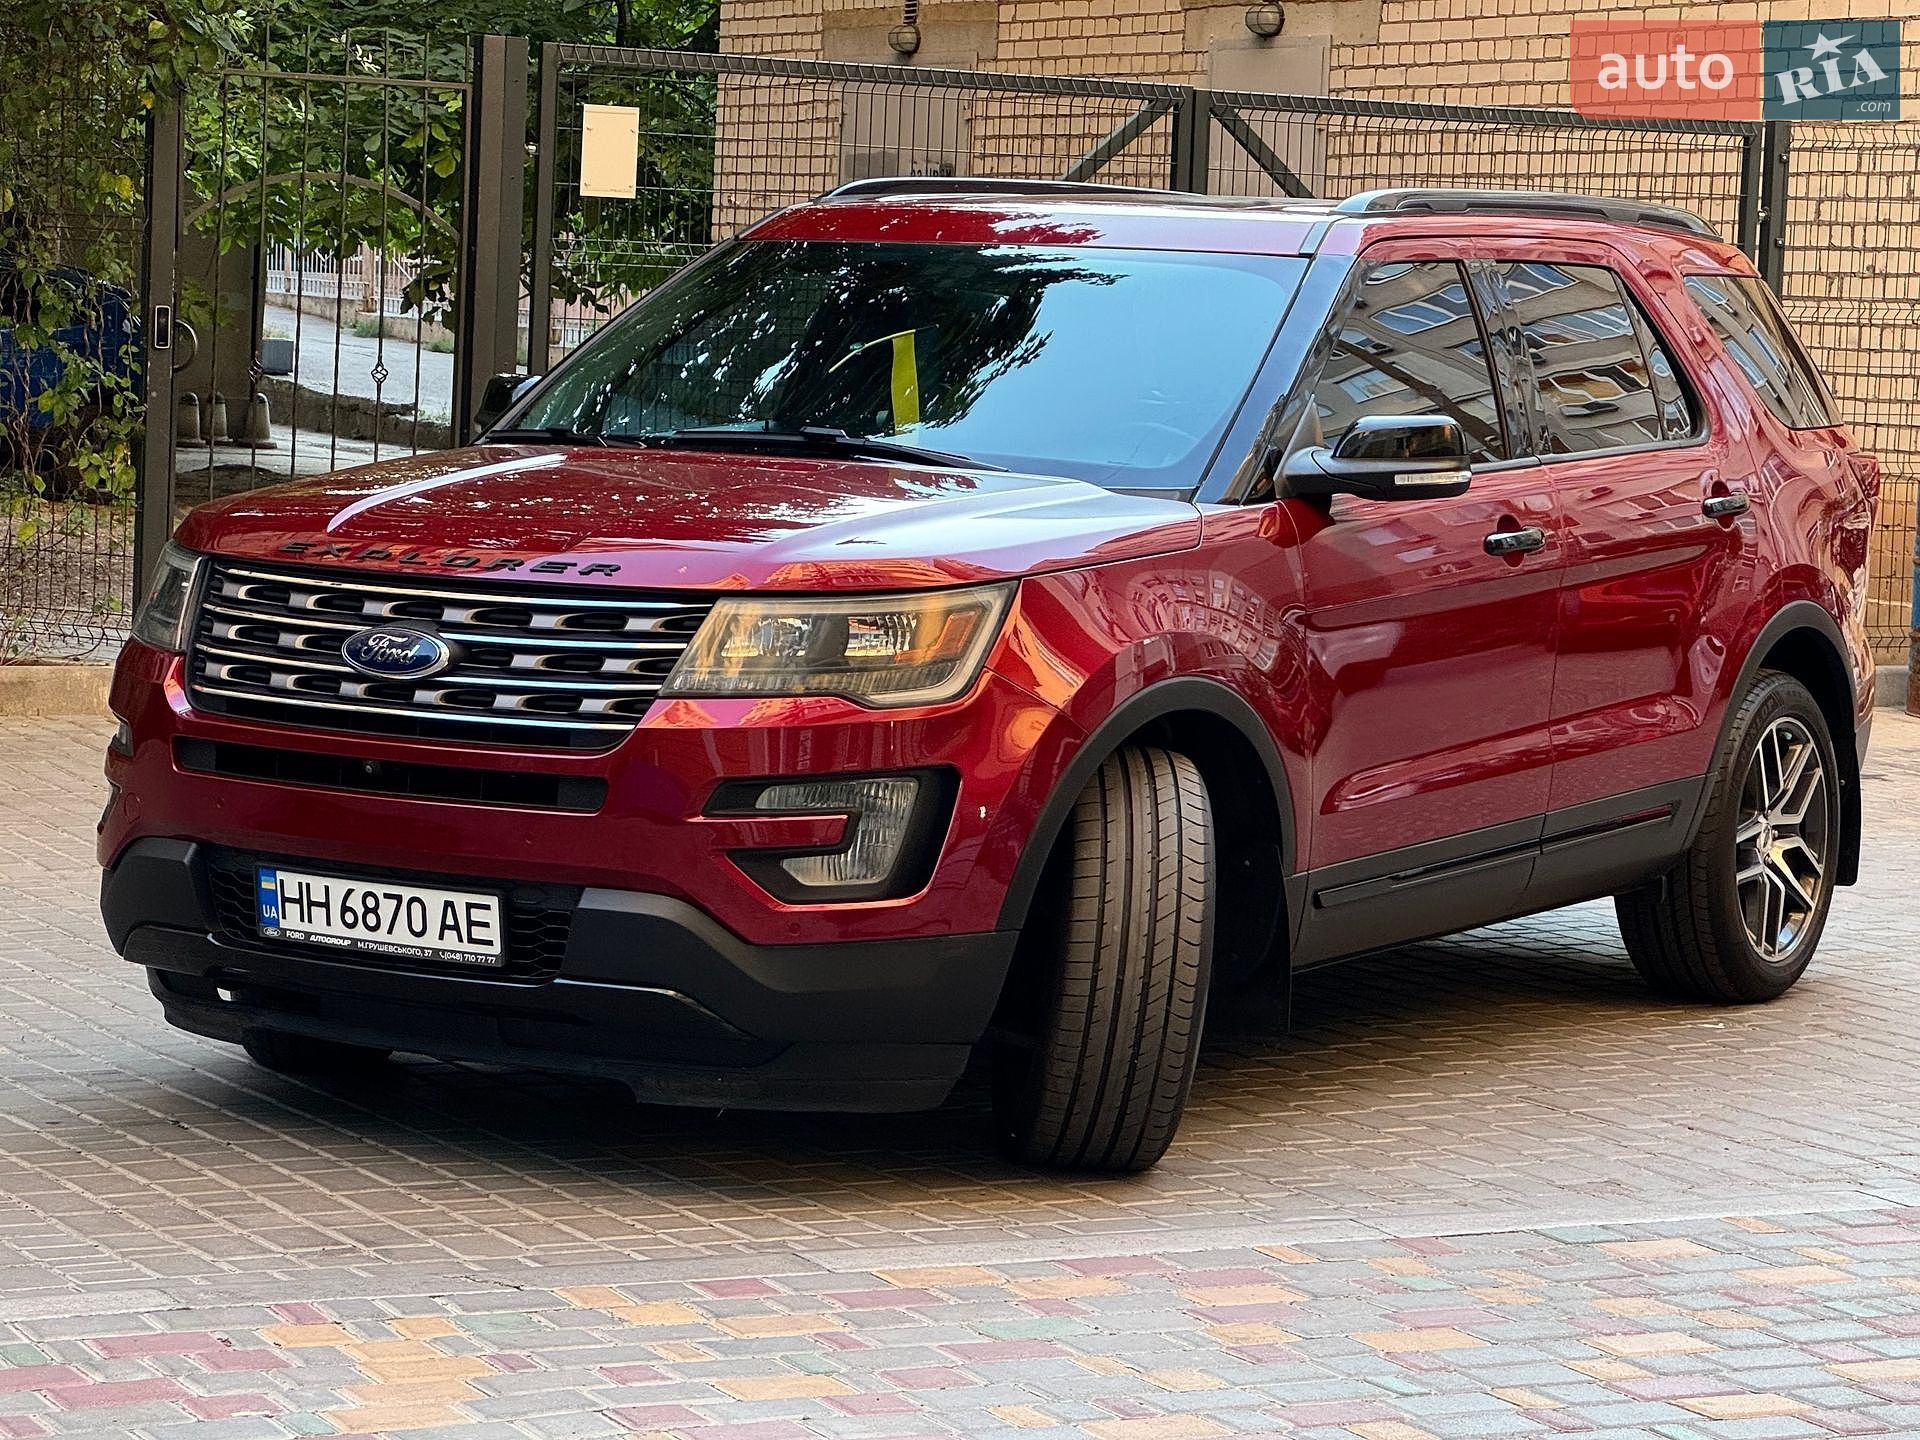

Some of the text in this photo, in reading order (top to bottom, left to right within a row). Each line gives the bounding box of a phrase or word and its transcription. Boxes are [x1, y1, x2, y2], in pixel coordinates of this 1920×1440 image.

[282, 542, 621, 577] EXPLORER
[361, 633, 420, 664] Ford
[262, 904, 278, 919] UA
[286, 930, 305, 940] FORD
[423, 949, 433, 957] 37
[444, 951, 496, 964] (048) 710 77 77
